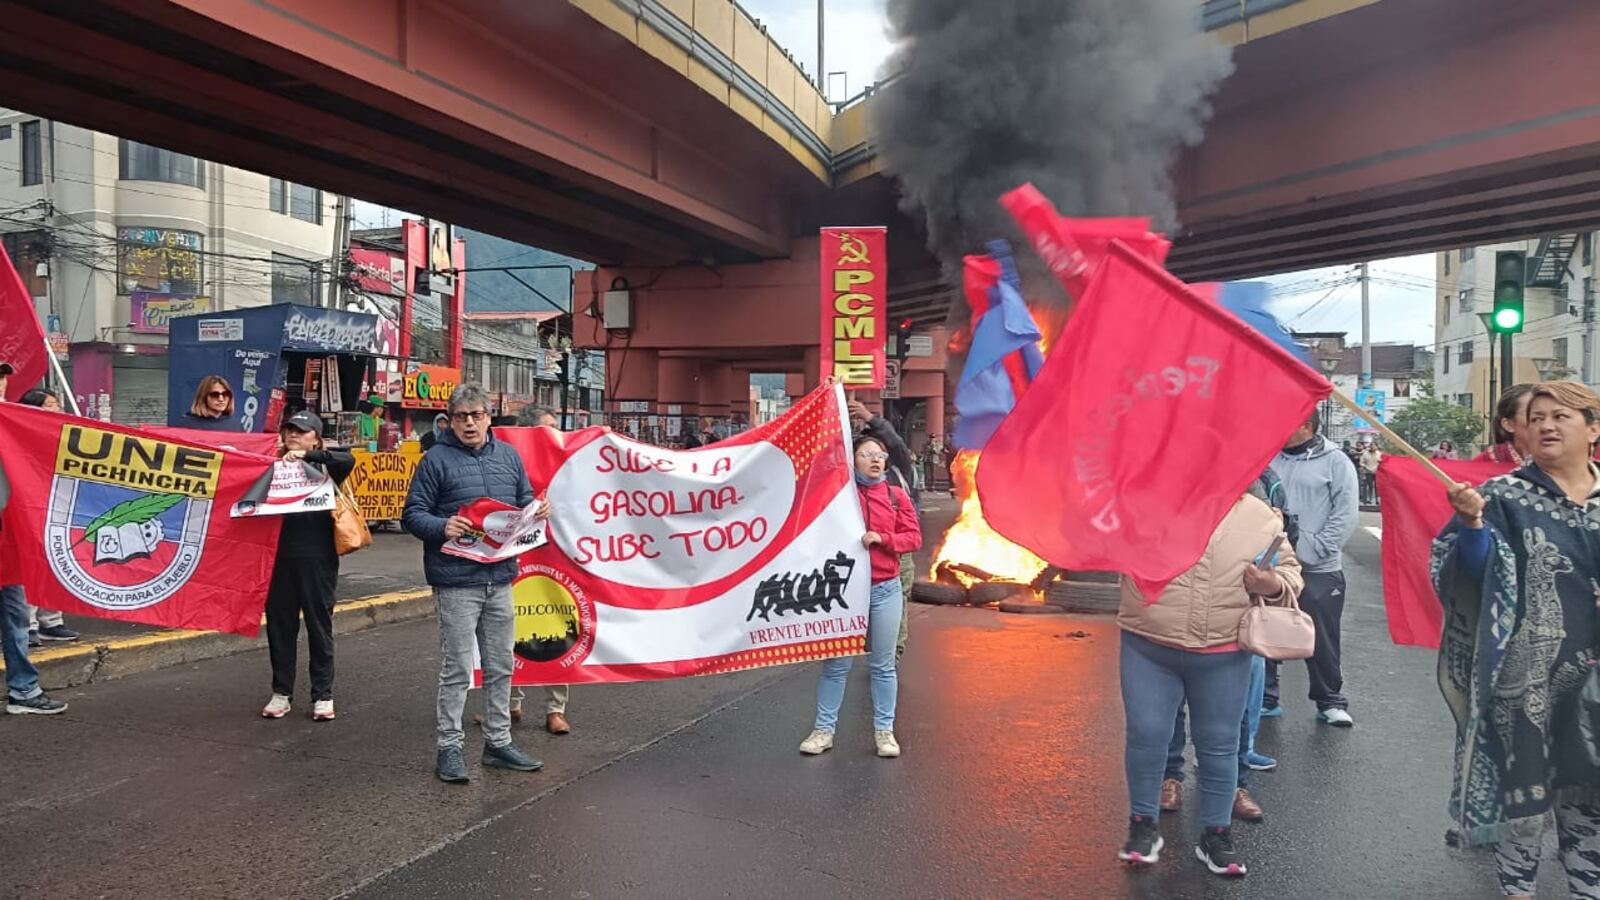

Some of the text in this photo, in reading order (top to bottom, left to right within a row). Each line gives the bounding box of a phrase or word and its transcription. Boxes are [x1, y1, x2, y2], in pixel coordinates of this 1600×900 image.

[834, 269, 876, 385] PCMLE
[404, 371, 456, 401] El Gordit
[67, 427, 216, 479] UNE
[371, 453, 407, 475] SECOS
[63, 459, 208, 495] PICHINCHA
[354, 495, 379, 507] COS
[381, 495, 395, 507] DE
[53, 535, 64, 557] POR
[574, 516, 768, 565] SUBE TODO
[57, 556, 73, 577] UNA
[164, 553, 193, 587] PUEBLO
[125, 590, 153, 602] PARA
[152, 584, 166, 595] EL
[750, 615, 868, 645] FRENTE POPULAR
